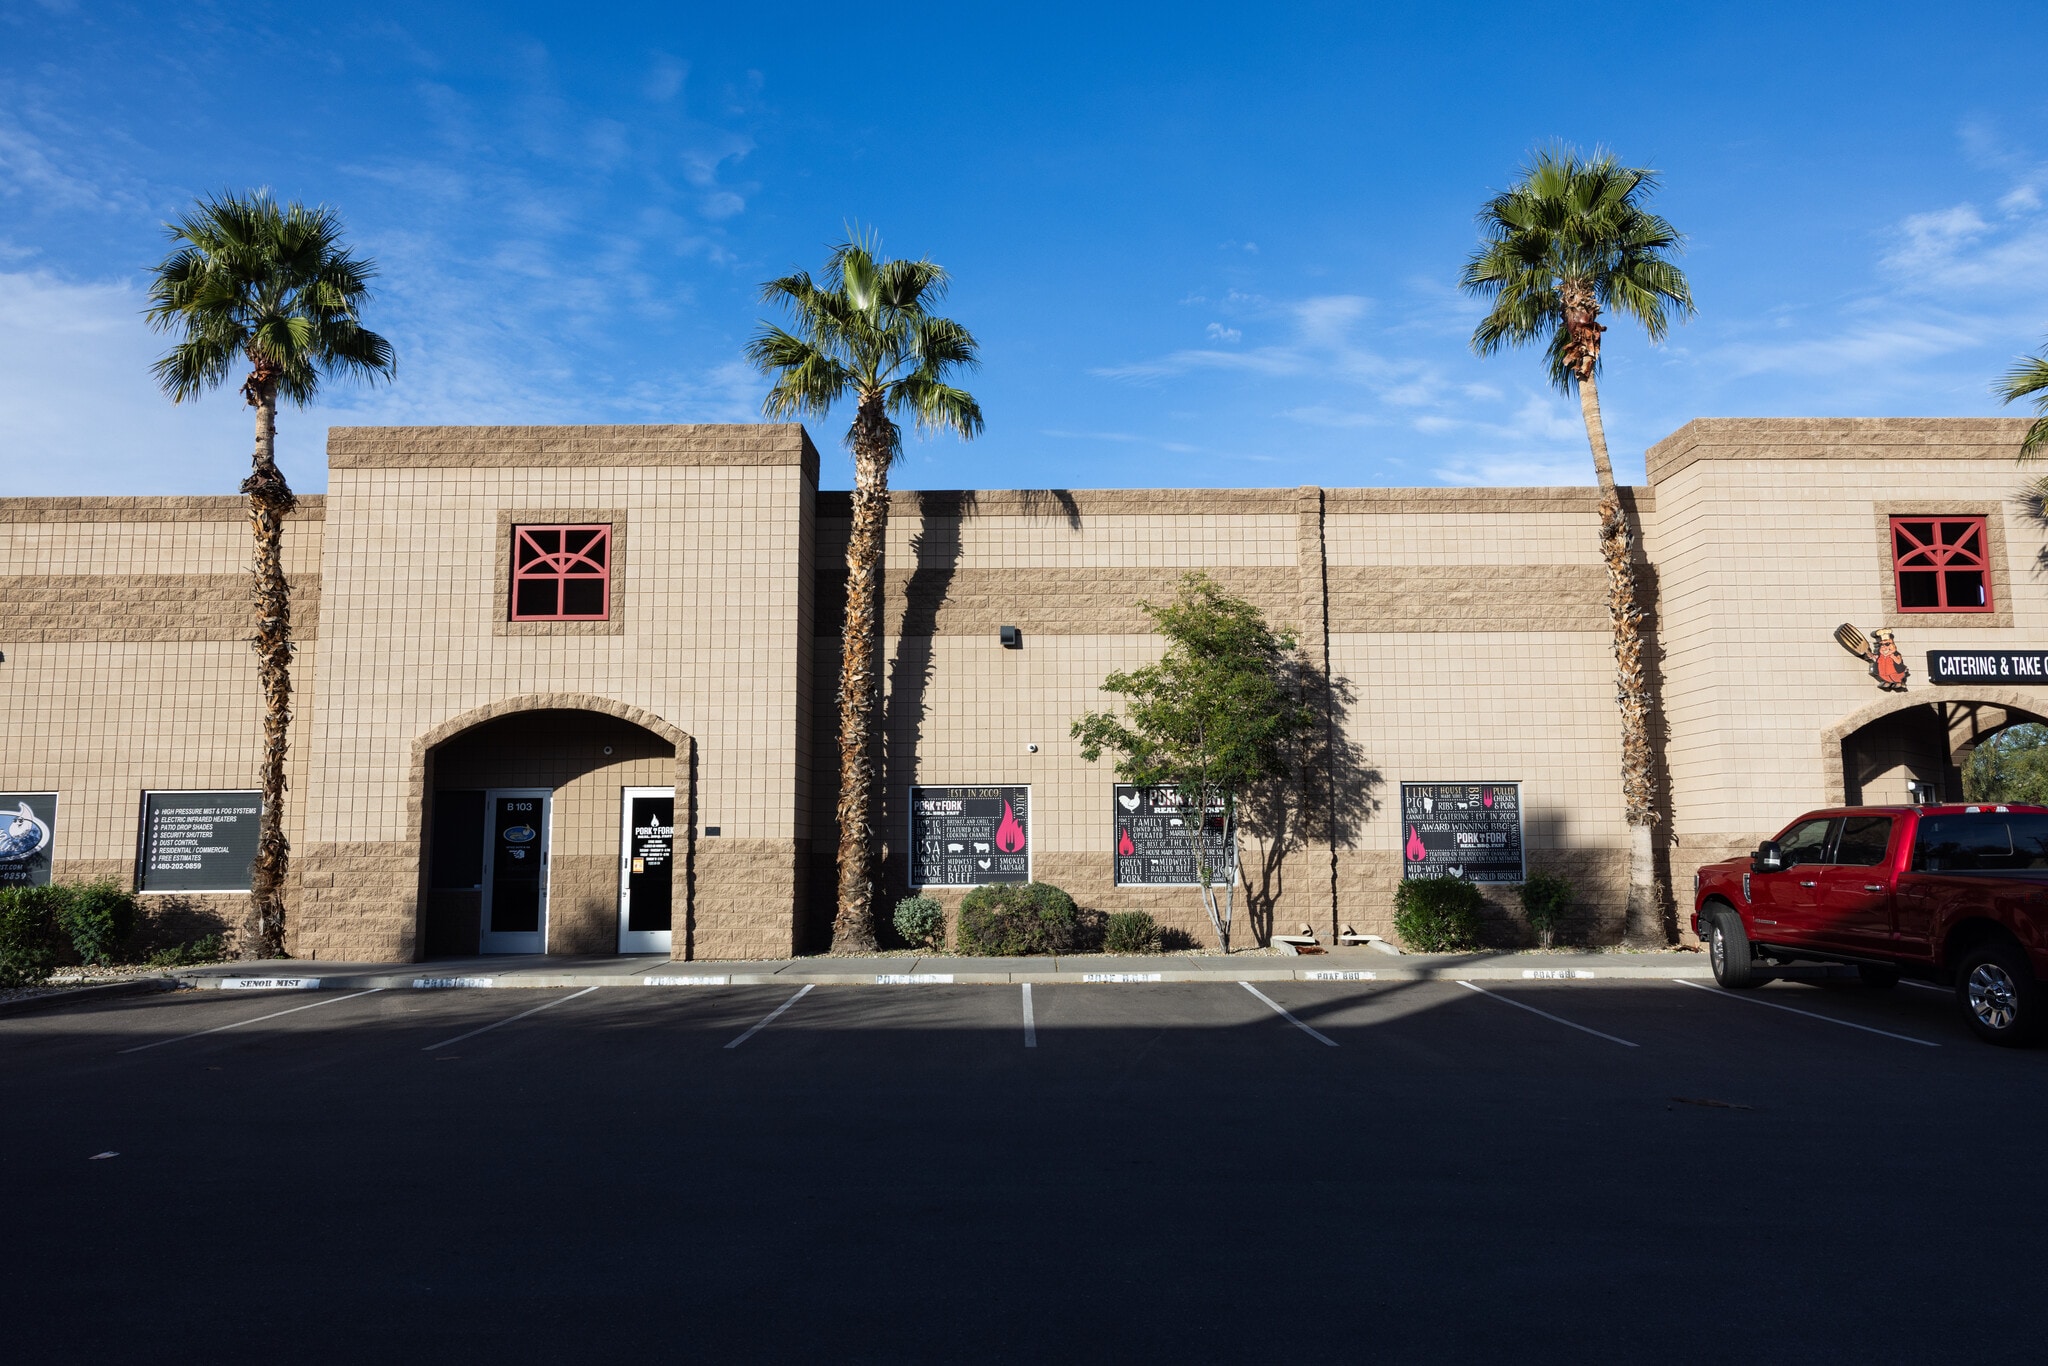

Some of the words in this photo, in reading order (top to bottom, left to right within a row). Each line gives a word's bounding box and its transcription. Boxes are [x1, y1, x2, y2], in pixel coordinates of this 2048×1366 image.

[1939, 656, 1997, 676] CATERING
[2000, 656, 2009, 675] &
[2012, 656, 2042, 676] TAKE
[968, 789, 976, 797] IN
[979, 789, 999, 797] 2009
[1406, 788, 1409, 797] I
[1413, 788, 1433, 797] LIKE
[1468, 787, 1480, 807] BBQ
[507, 803, 514, 811] B
[516, 803, 532, 811] 103
[914, 801, 935, 810] PORK
[942, 801, 962, 810] FORK
[1016, 793, 1024, 816] JUICY
[1407, 798, 1422, 807] PIG
[1456, 832, 1478, 843] PORK
[1486, 832, 1507, 843] FORK
[948, 873, 972, 883] BEEF
